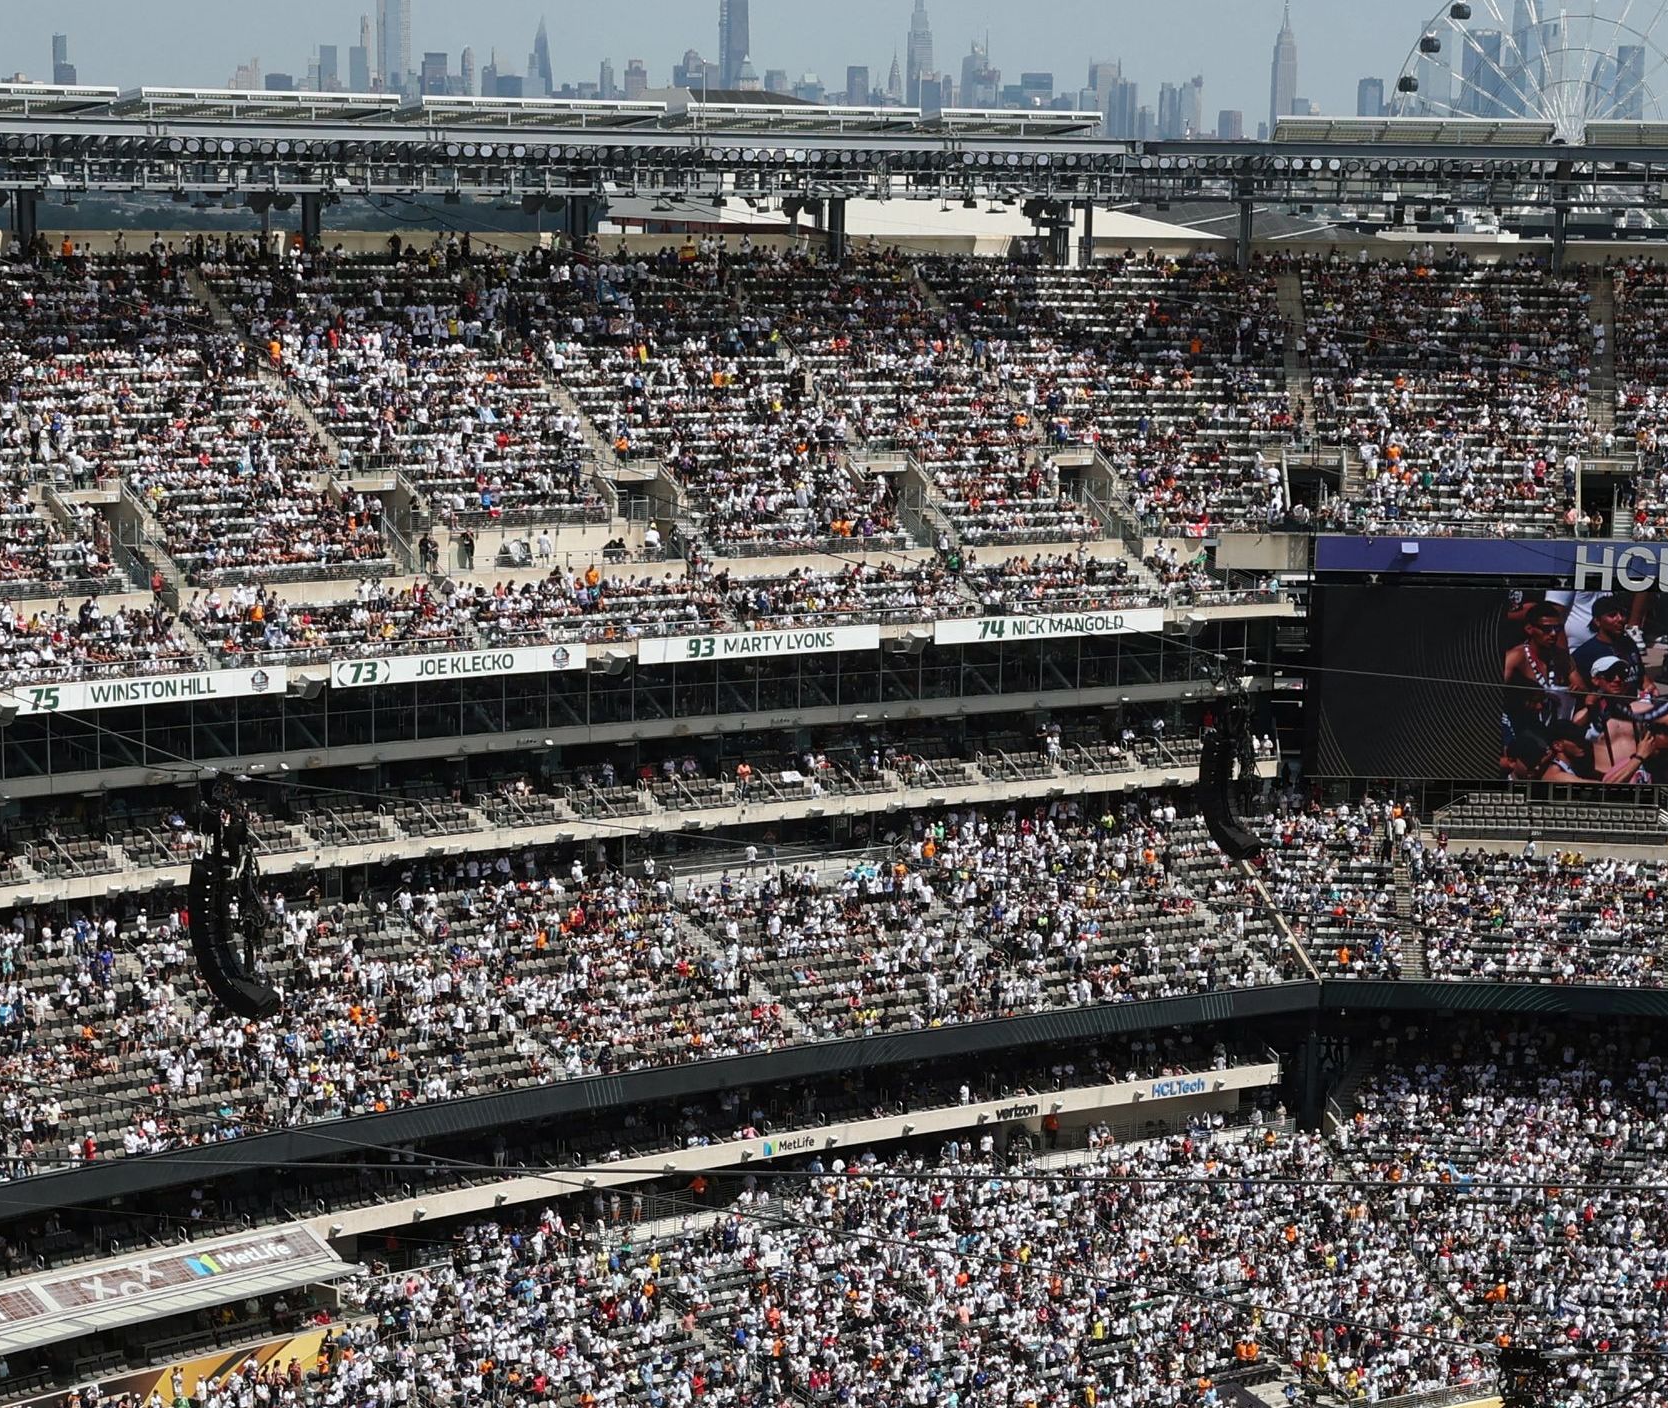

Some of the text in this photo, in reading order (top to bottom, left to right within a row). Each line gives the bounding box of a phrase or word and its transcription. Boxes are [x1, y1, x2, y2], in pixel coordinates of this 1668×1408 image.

[977, 614, 1124, 640] 74 NICK MANGOLD
[686, 631, 835, 659] 93 MARTY LYONS
[349, 653, 515, 684] 73 JOE KLECKO
[29, 676, 217, 711] 75 WINSTON HILL
[1151, 1077, 1205, 1099] HCLTech
[995, 1102, 1039, 1122] verizon
[778, 1136, 815, 1153] MetLife
[218, 1241, 292, 1268] MetLife
